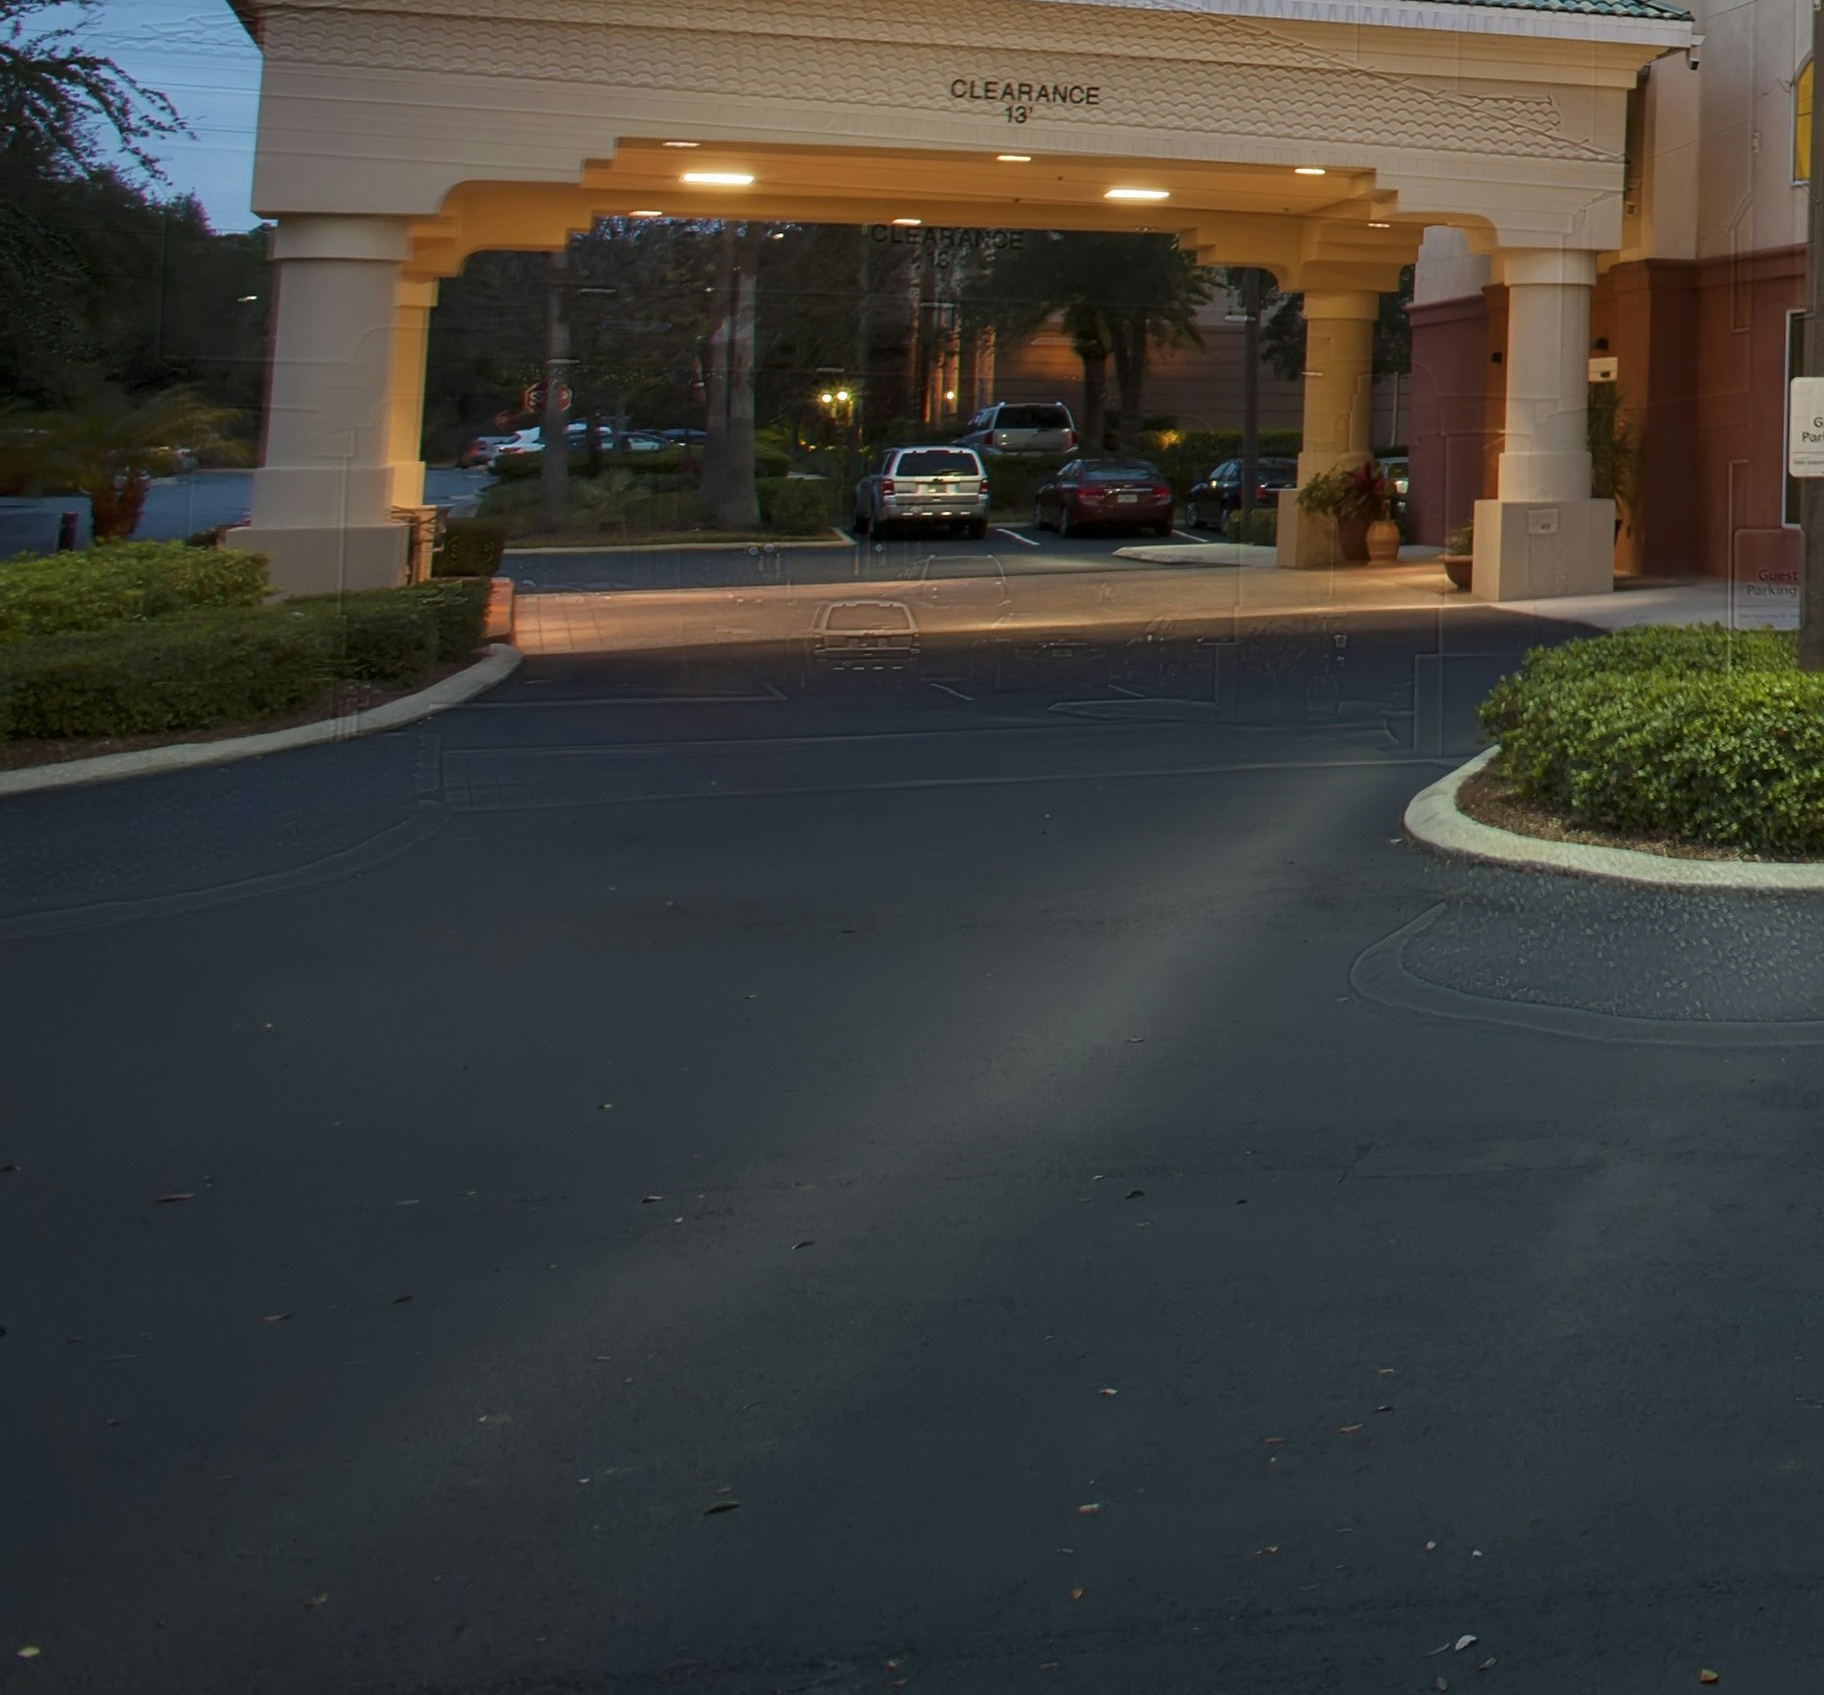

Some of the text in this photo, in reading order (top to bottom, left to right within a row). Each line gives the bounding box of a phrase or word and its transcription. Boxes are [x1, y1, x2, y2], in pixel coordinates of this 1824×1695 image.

[951, 79, 1100, 105] CLEARANCE
[1758, 569, 1799, 582] Guest
[1746, 584, 1798, 598] Parking
